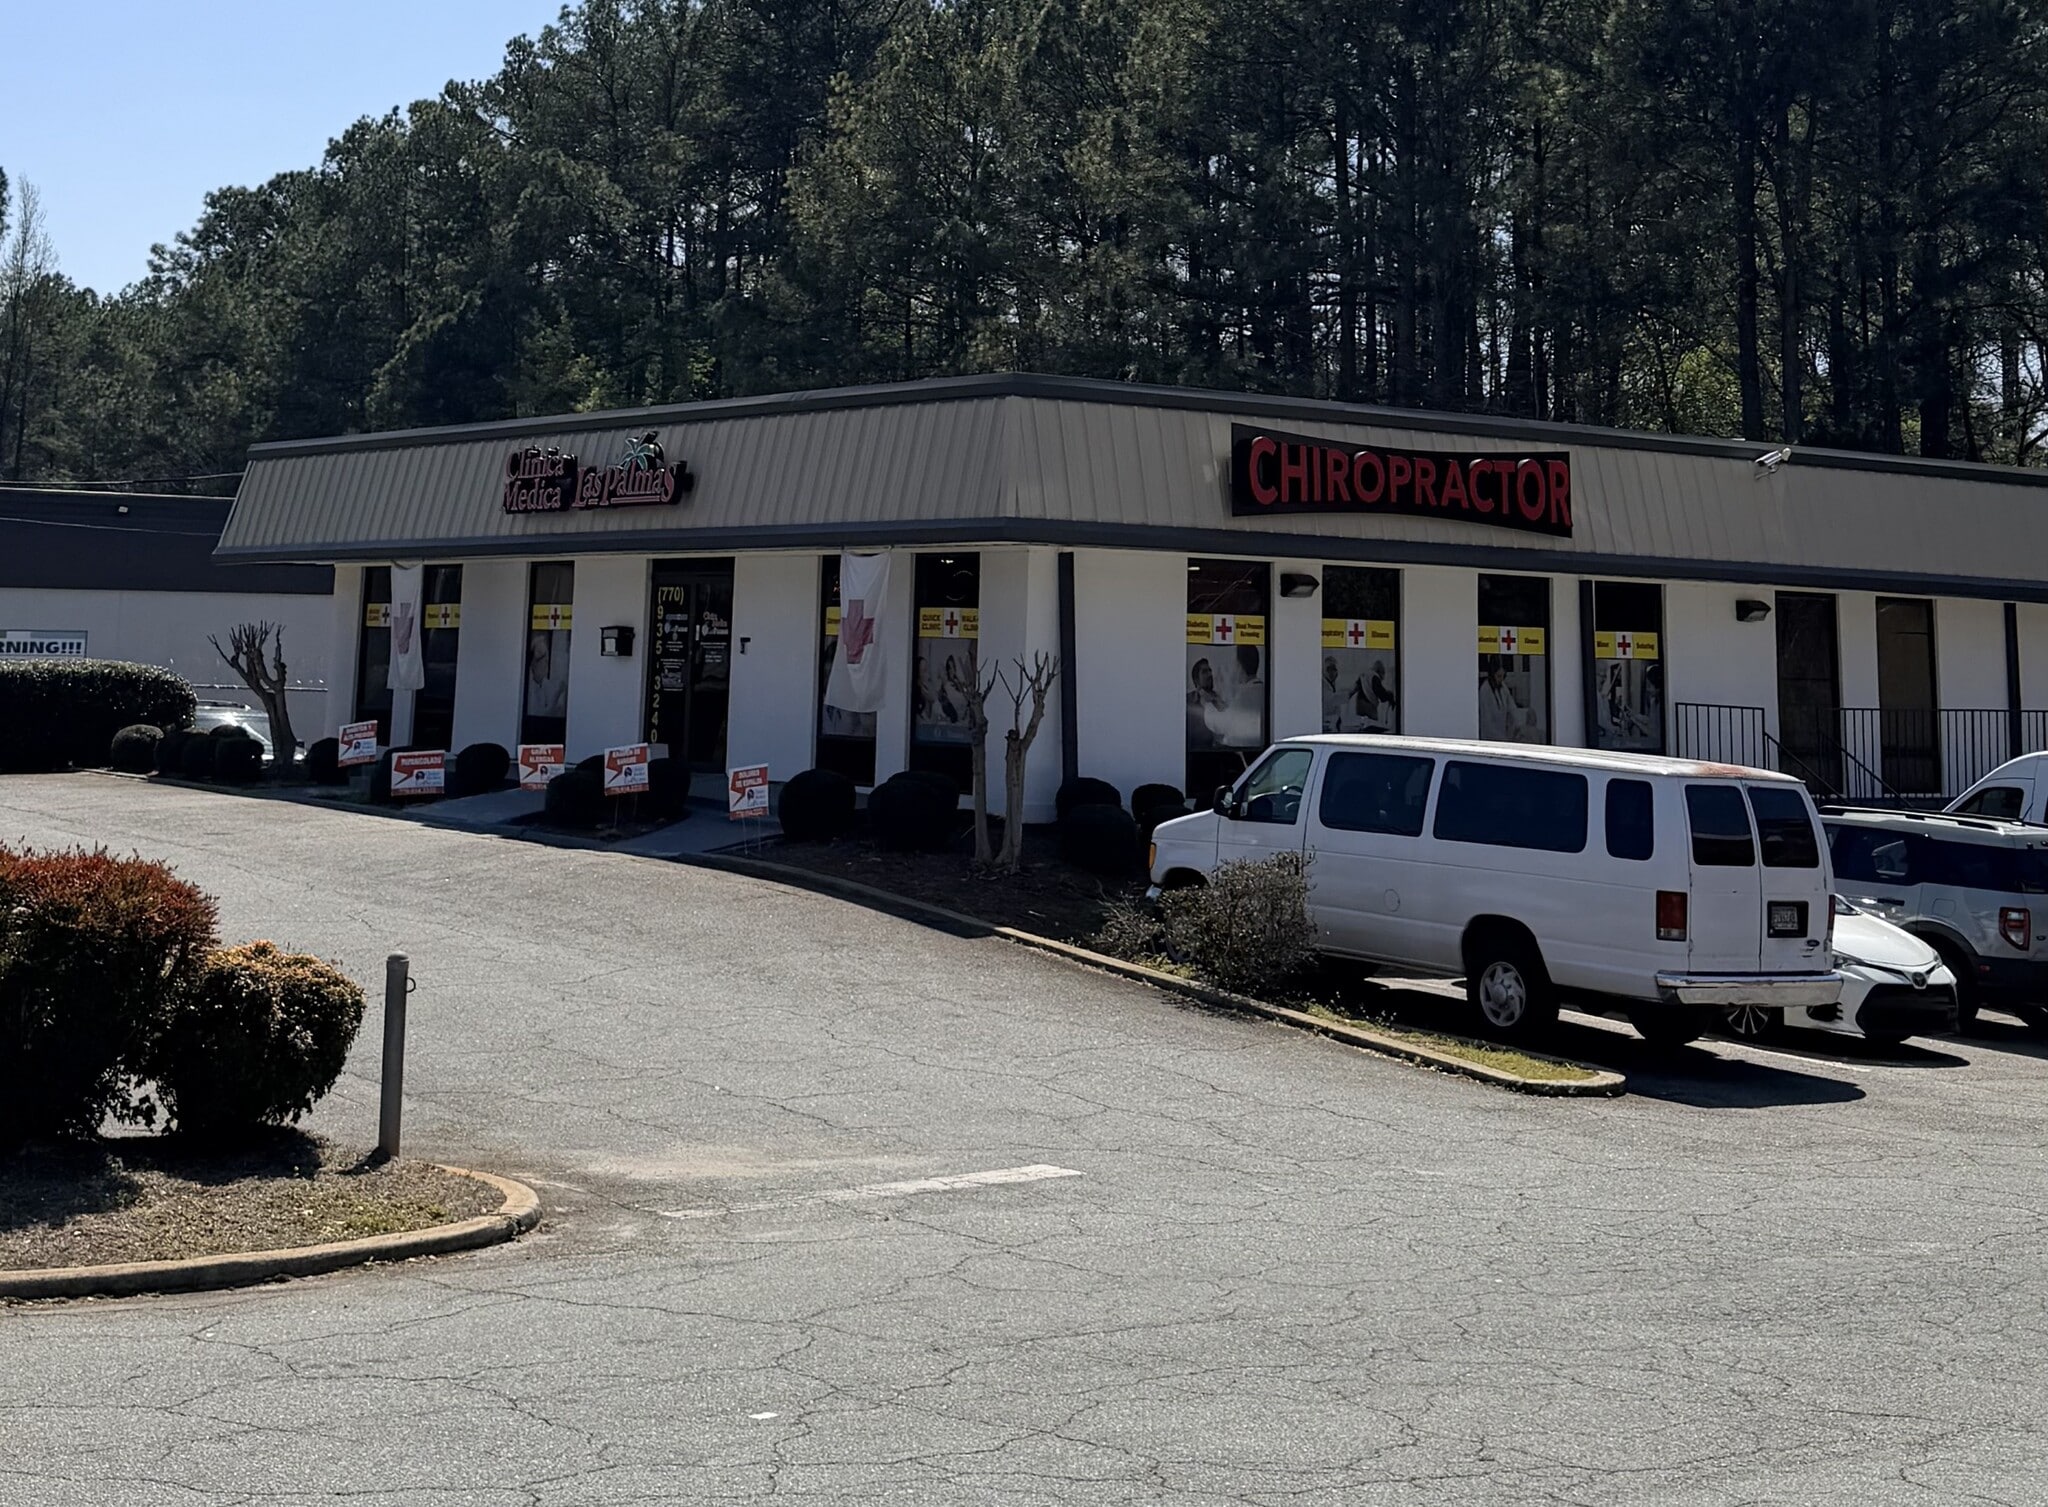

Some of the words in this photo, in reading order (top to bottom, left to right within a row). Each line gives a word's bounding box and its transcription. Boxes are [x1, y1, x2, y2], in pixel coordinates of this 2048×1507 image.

[506, 450, 564, 478] Clinica
[505, 478, 561, 511] Medica
[572, 467, 602, 507] Las
[1248, 435, 1573, 527] CHIROPRACTOR
[658, 587, 684, 605] (770)
